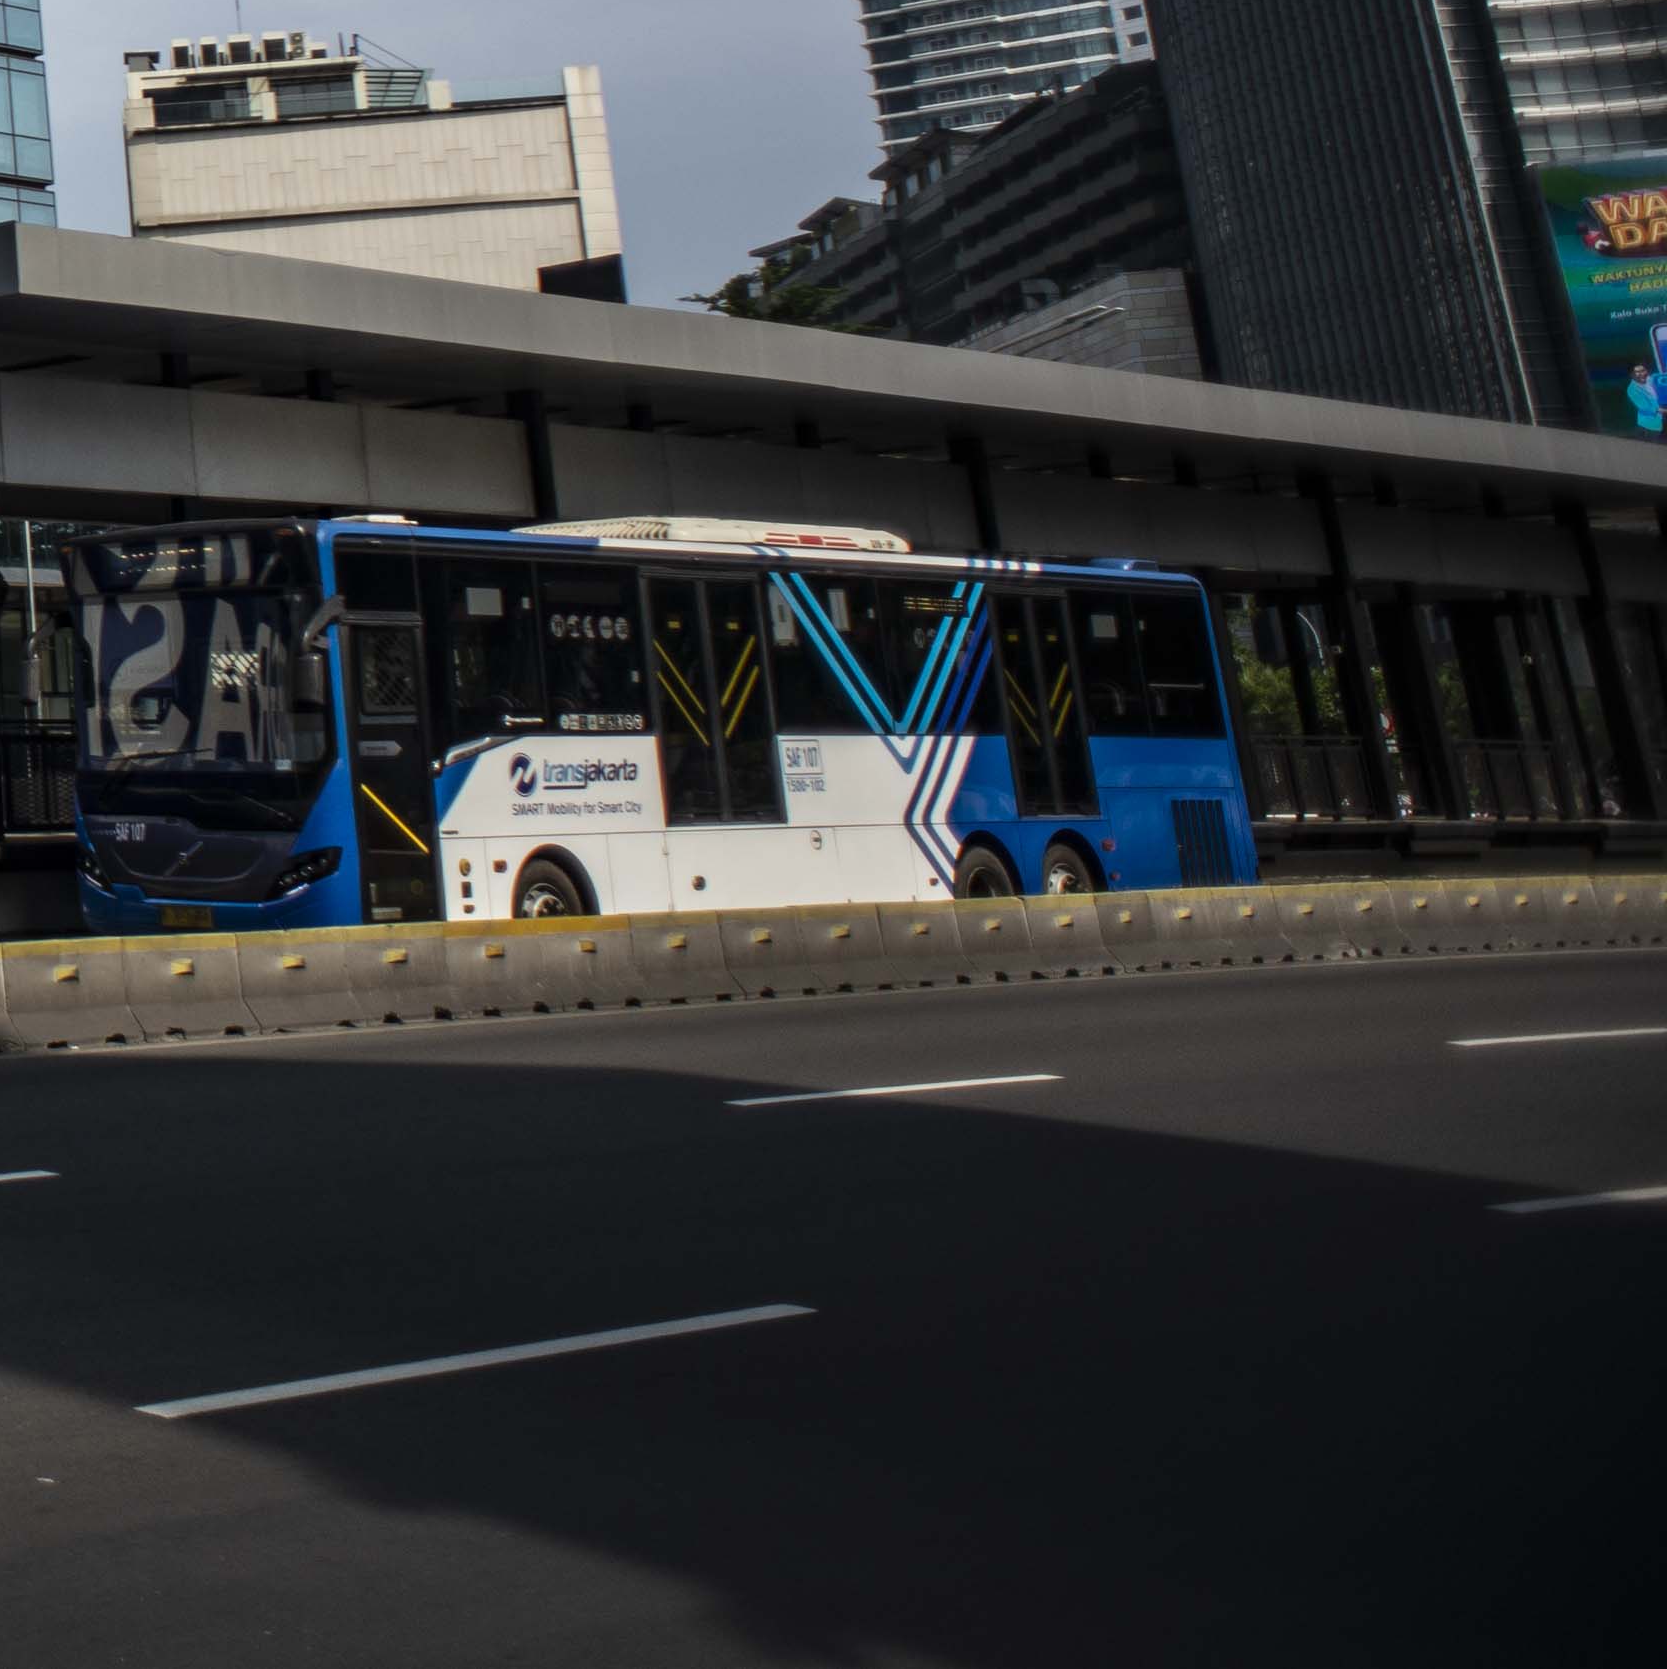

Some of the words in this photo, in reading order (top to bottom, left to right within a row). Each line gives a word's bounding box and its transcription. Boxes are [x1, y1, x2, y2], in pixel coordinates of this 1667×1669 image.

[542, 759, 637, 790] transjakarta
[511, 802, 544, 816] SMART
[547, 802, 581, 816] Mobility
[584, 802, 596, 814] for
[597, 801, 623, 814] Smart
[625, 800, 643, 815] City
